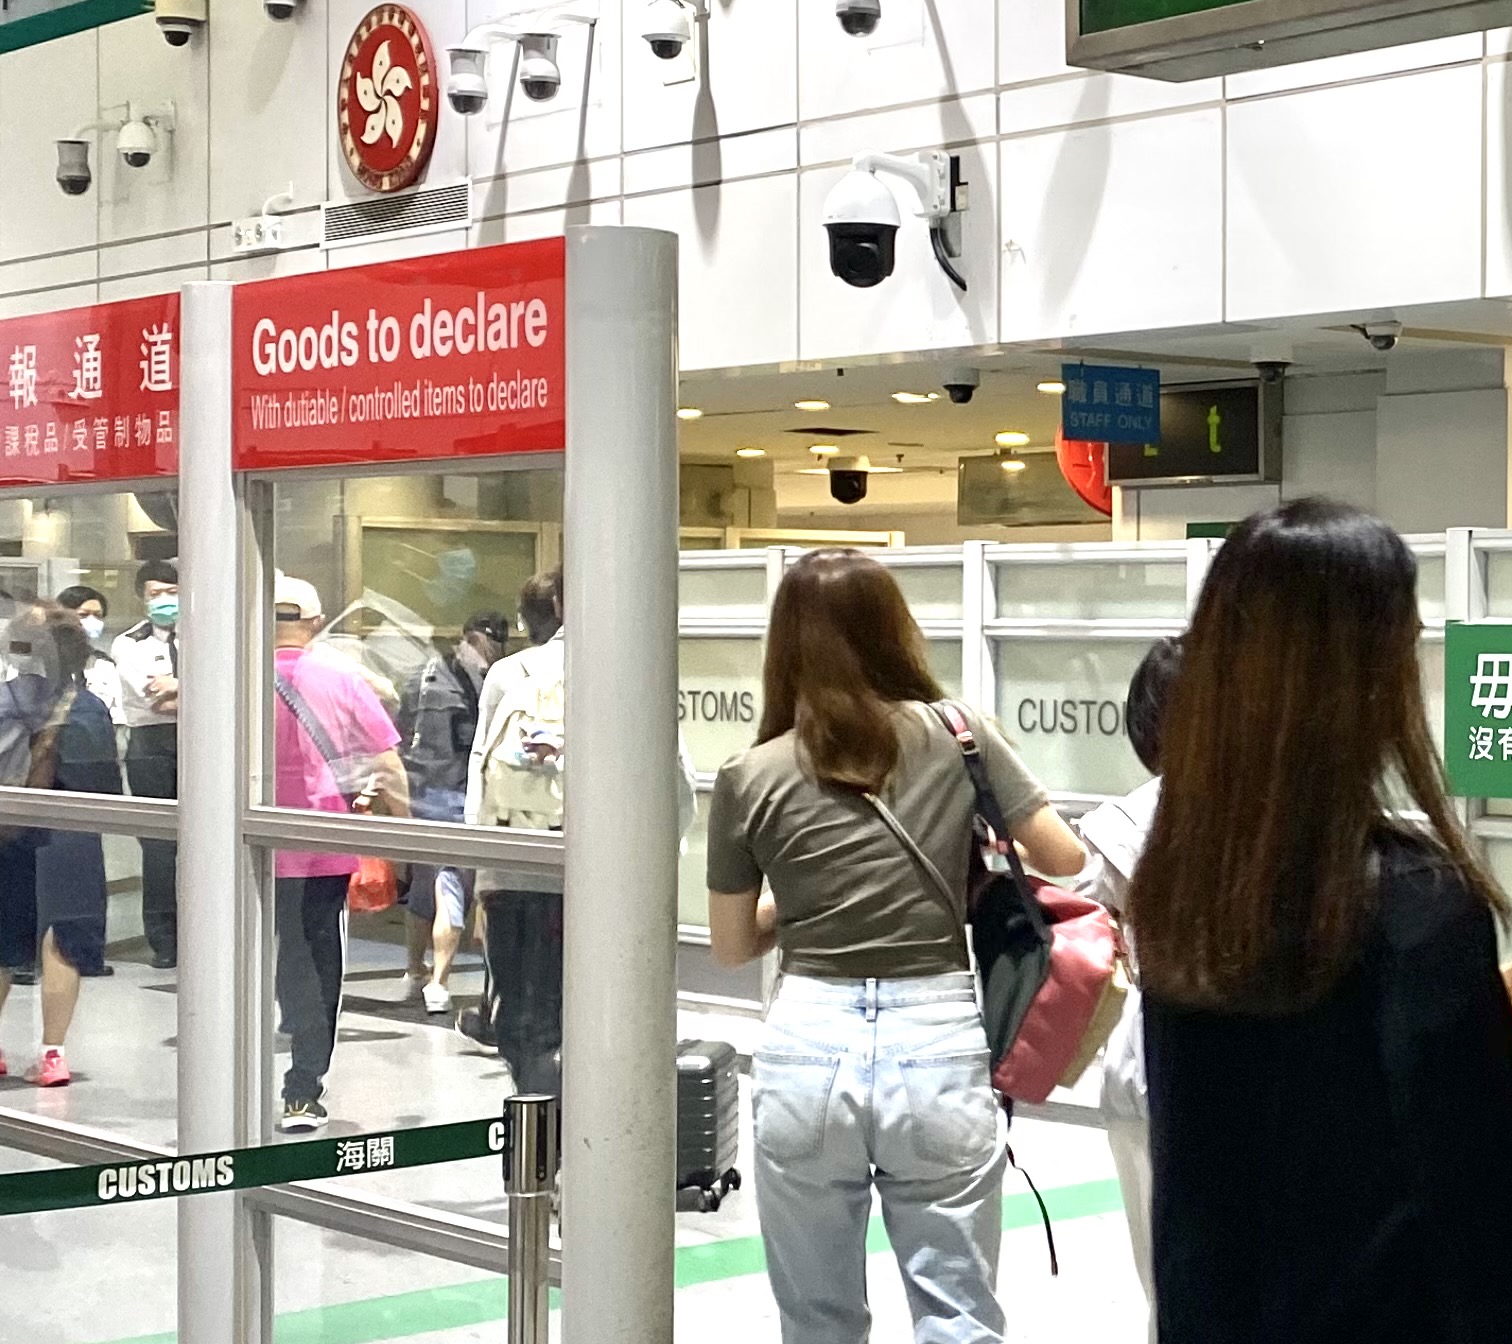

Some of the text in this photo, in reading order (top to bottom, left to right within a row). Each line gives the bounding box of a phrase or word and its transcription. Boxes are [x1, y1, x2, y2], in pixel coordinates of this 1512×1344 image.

[252, 291, 548, 376] Goods to declare
[9, 322, 173, 410] 報通道
[251, 391, 281, 430] With
[284, 387, 339, 428] dutiable
[349, 379, 421, 422] controlled
[424, 377, 465, 416] items
[469, 375, 484, 413] to
[487, 368, 548, 411] declare
[1067, 379, 1154, 408] 職員通道
[1070, 413, 1152, 431] STAFF ONLY
[678, 690, 754, 724] STOMS
[1018, 697, 1127, 736] CUSTO
[336, 1136, 395, 1172] 海關
[97, 1155, 234, 1201] CUSTOMS
